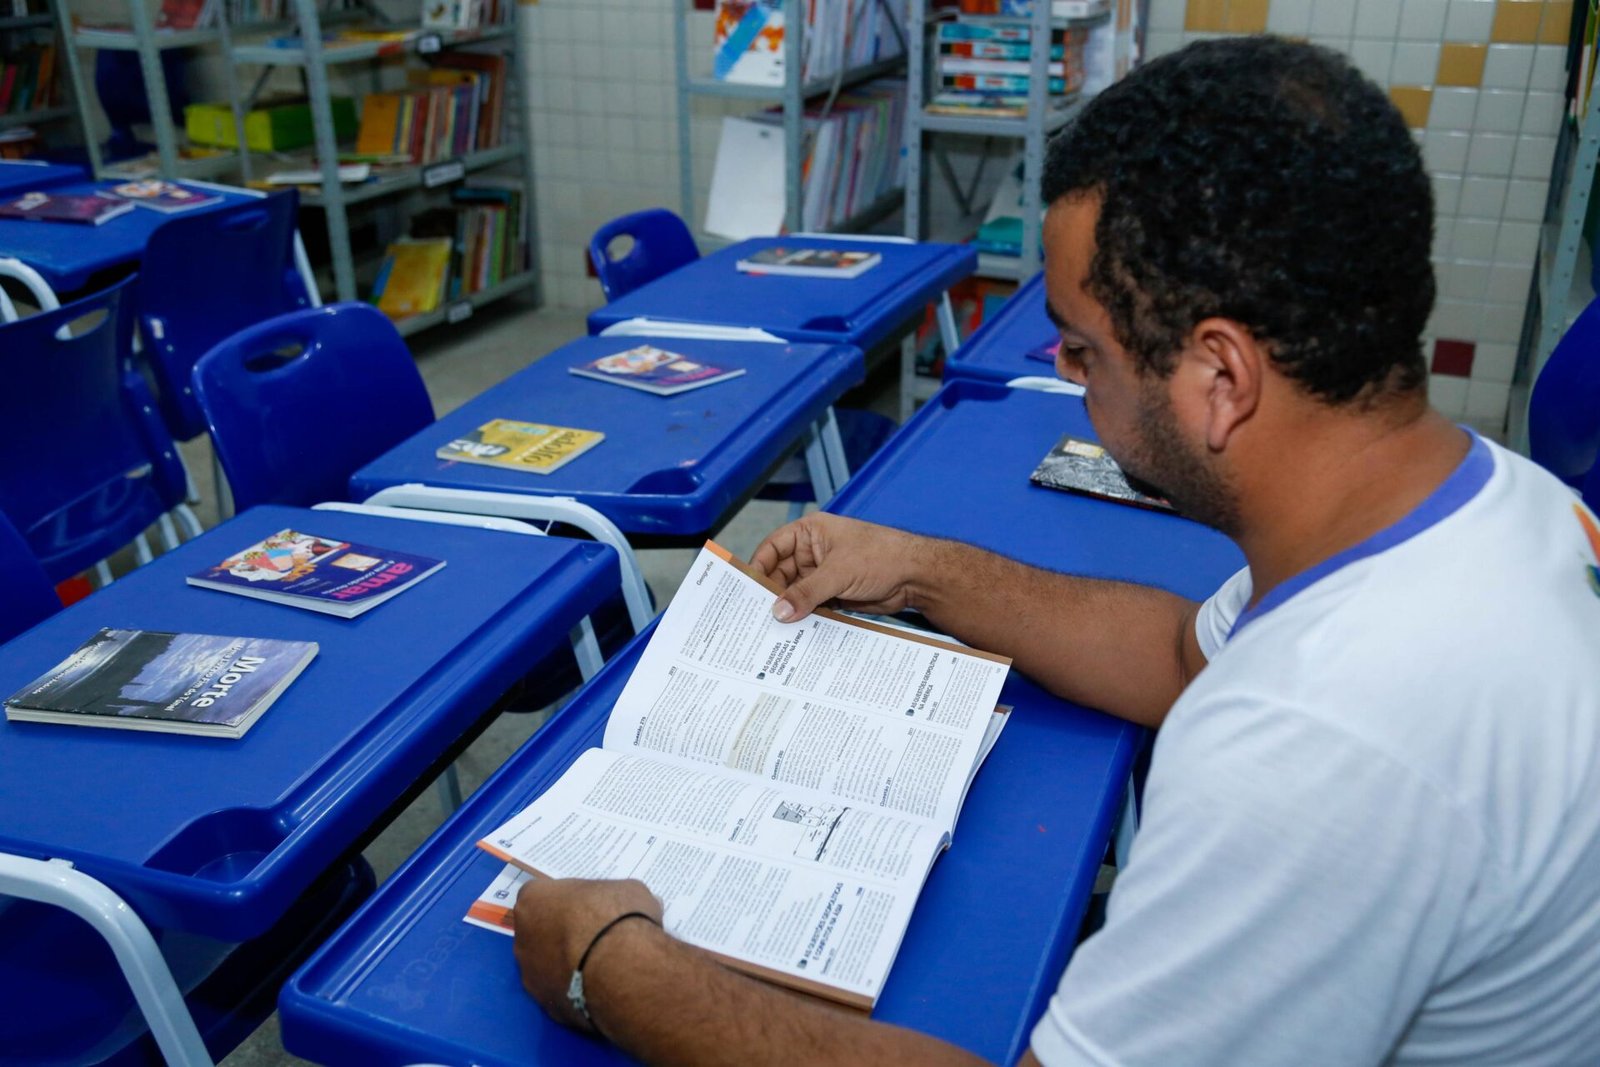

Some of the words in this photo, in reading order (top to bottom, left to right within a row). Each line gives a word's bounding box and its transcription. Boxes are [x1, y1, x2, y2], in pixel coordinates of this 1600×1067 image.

[331, 562, 414, 599] amar
[696, 560, 714, 585] Geografia
[766, 642, 781, 665] QUESTÕES
[769, 643, 790, 673] GEOPOLÍTICAS
[776, 652, 793, 676] CONFLITOS
[793, 629, 804, 645] ÁFRICA
[189, 656, 267, 708] Morte
[194, 675, 211, 689] Fim
[913, 680, 928, 702] QUESTÕES
[923, 652, 940, 681] GEOPOLÍTICAS
[921, 684, 934, 703] AMÉRICA
[633, 725, 642, 746] Questão
[771, 759, 780, 780] Questão
[880, 786, 889, 807] Questão
